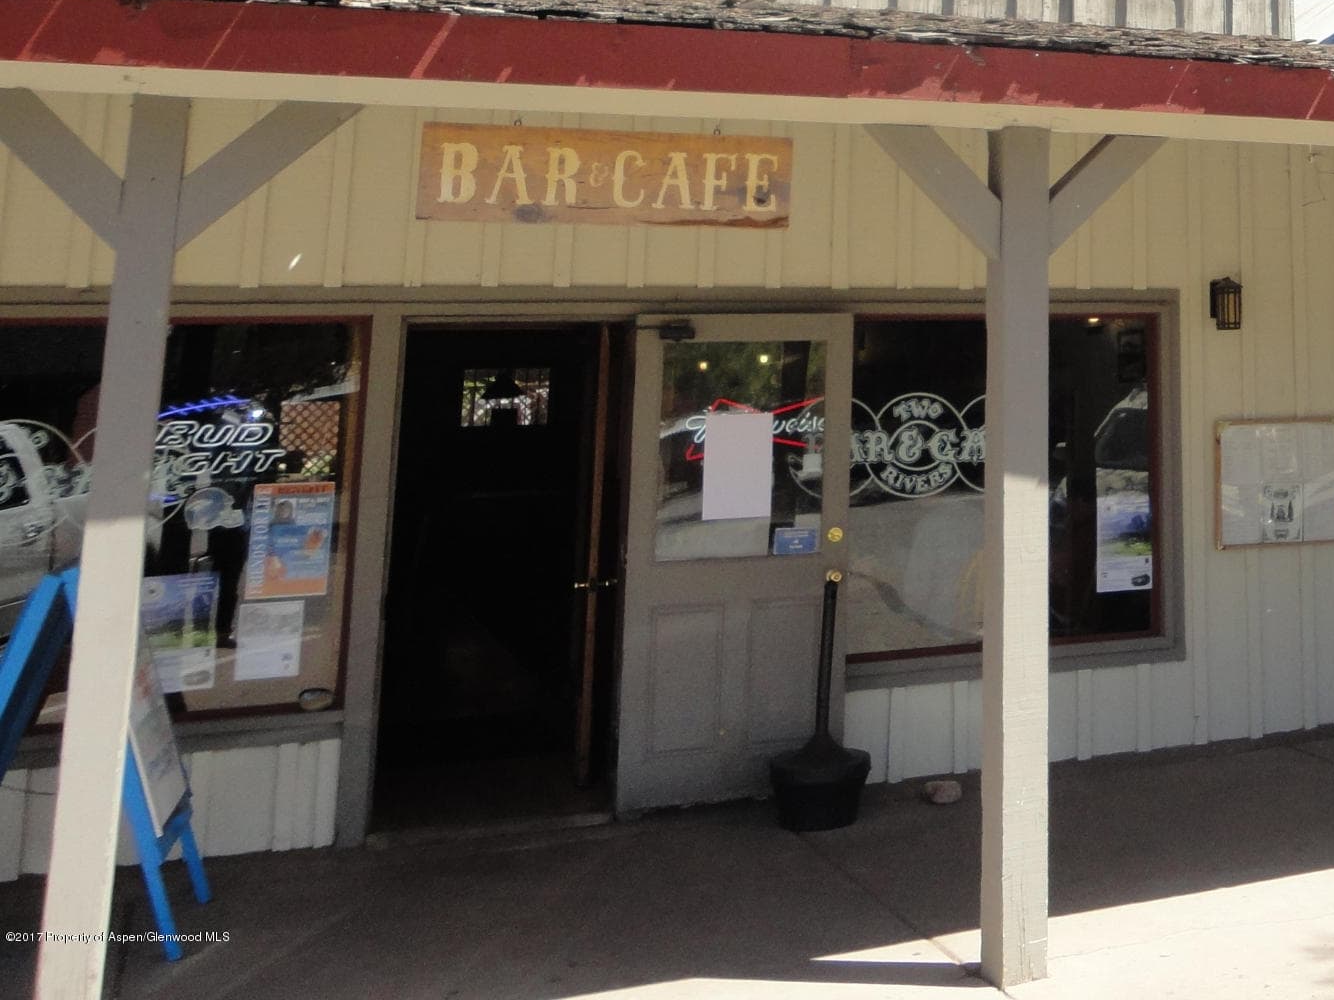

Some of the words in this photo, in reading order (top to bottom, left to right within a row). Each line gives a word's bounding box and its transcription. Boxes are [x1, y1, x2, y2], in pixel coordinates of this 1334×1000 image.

[436, 141, 582, 208] BAR
[612, 149, 779, 213] CAFE
[892, 398, 943, 420] TWO
[154, 420, 274, 449] BUD
[880, 462, 953, 494] RIVERS
